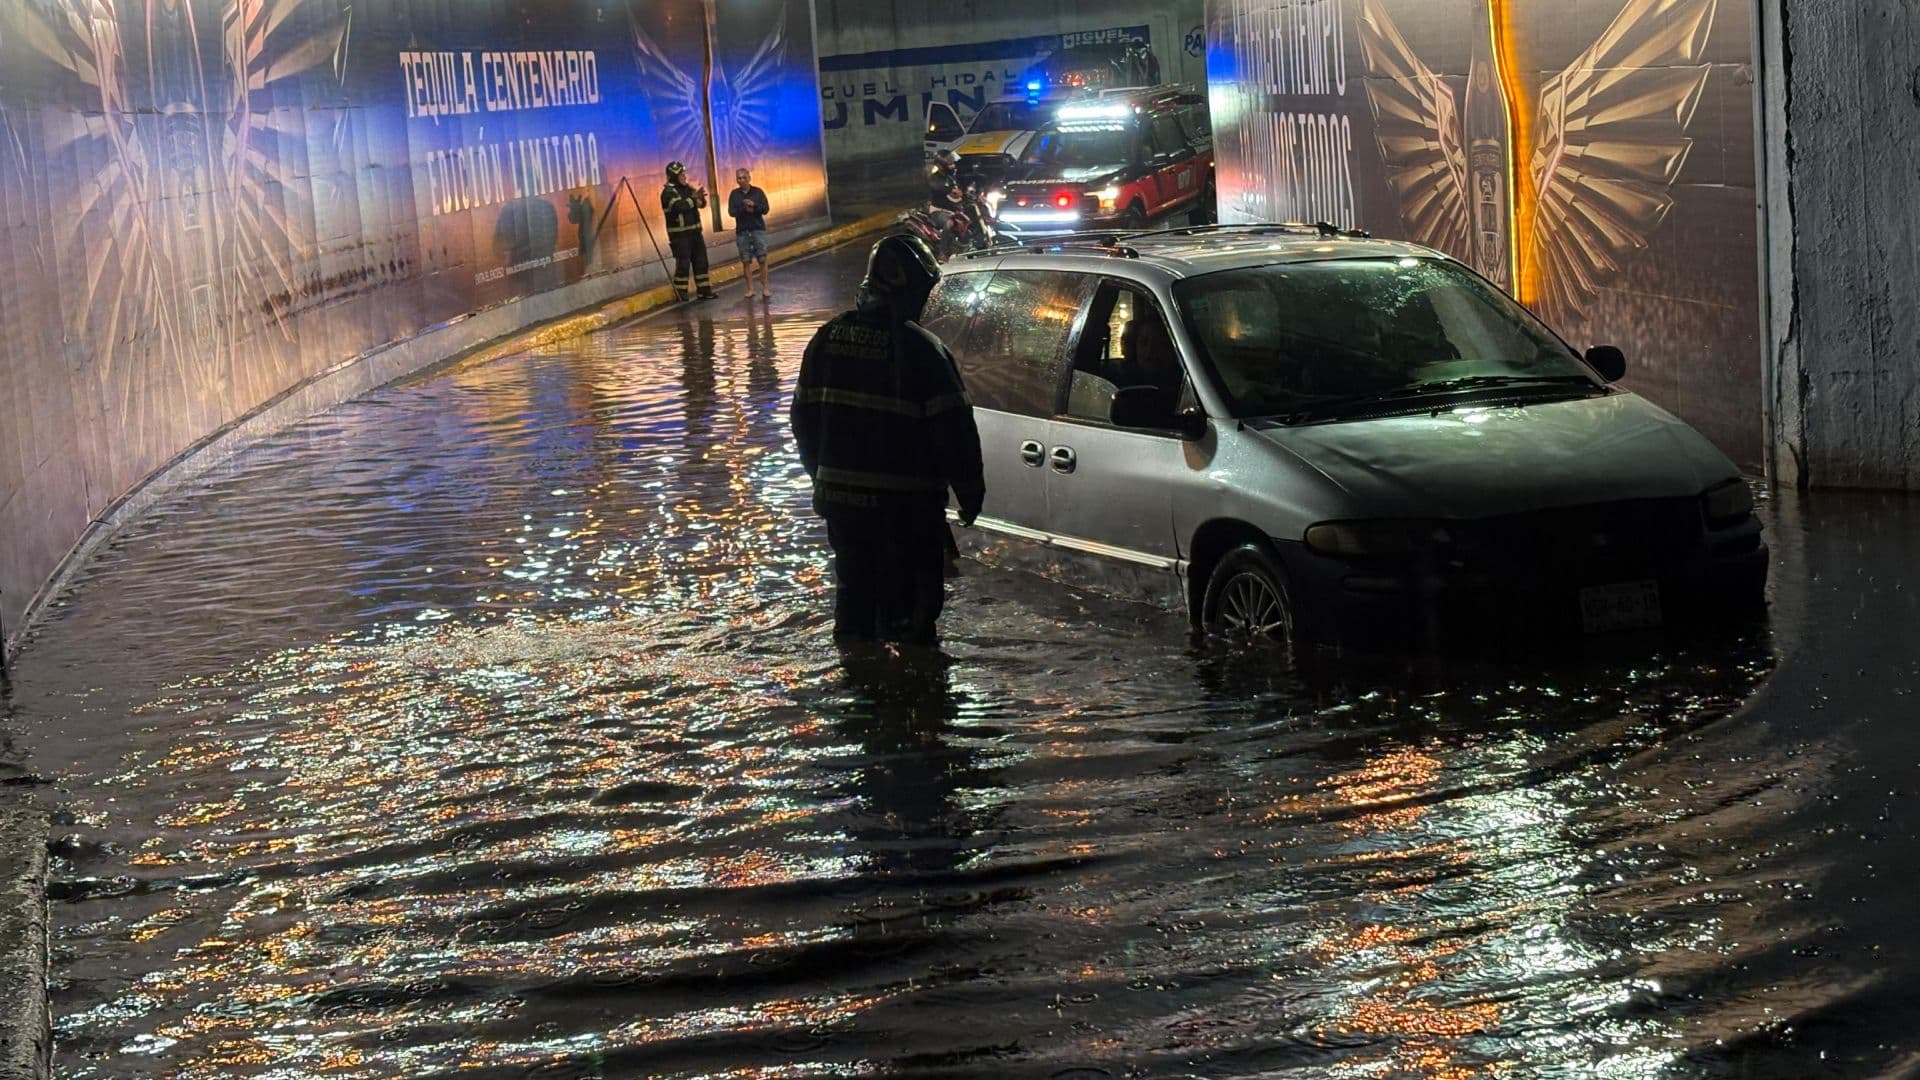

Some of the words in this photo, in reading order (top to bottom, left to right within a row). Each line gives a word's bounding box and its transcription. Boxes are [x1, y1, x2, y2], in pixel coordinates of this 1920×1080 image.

[1184, 32, 1206, 52] PA
[1287, 0, 1345, 96] TIEMPO
[400, 52, 480, 126] TEQUILA
[481, 51, 599, 112] CENTENARIO
[821, 81, 898, 100] GUEL
[931, 68, 1017, 88] HIDAL
[427, 126, 505, 216] EDICIÓN
[509, 132, 601, 199] LIMITADA
[1298, 113, 1356, 232] TODOS
